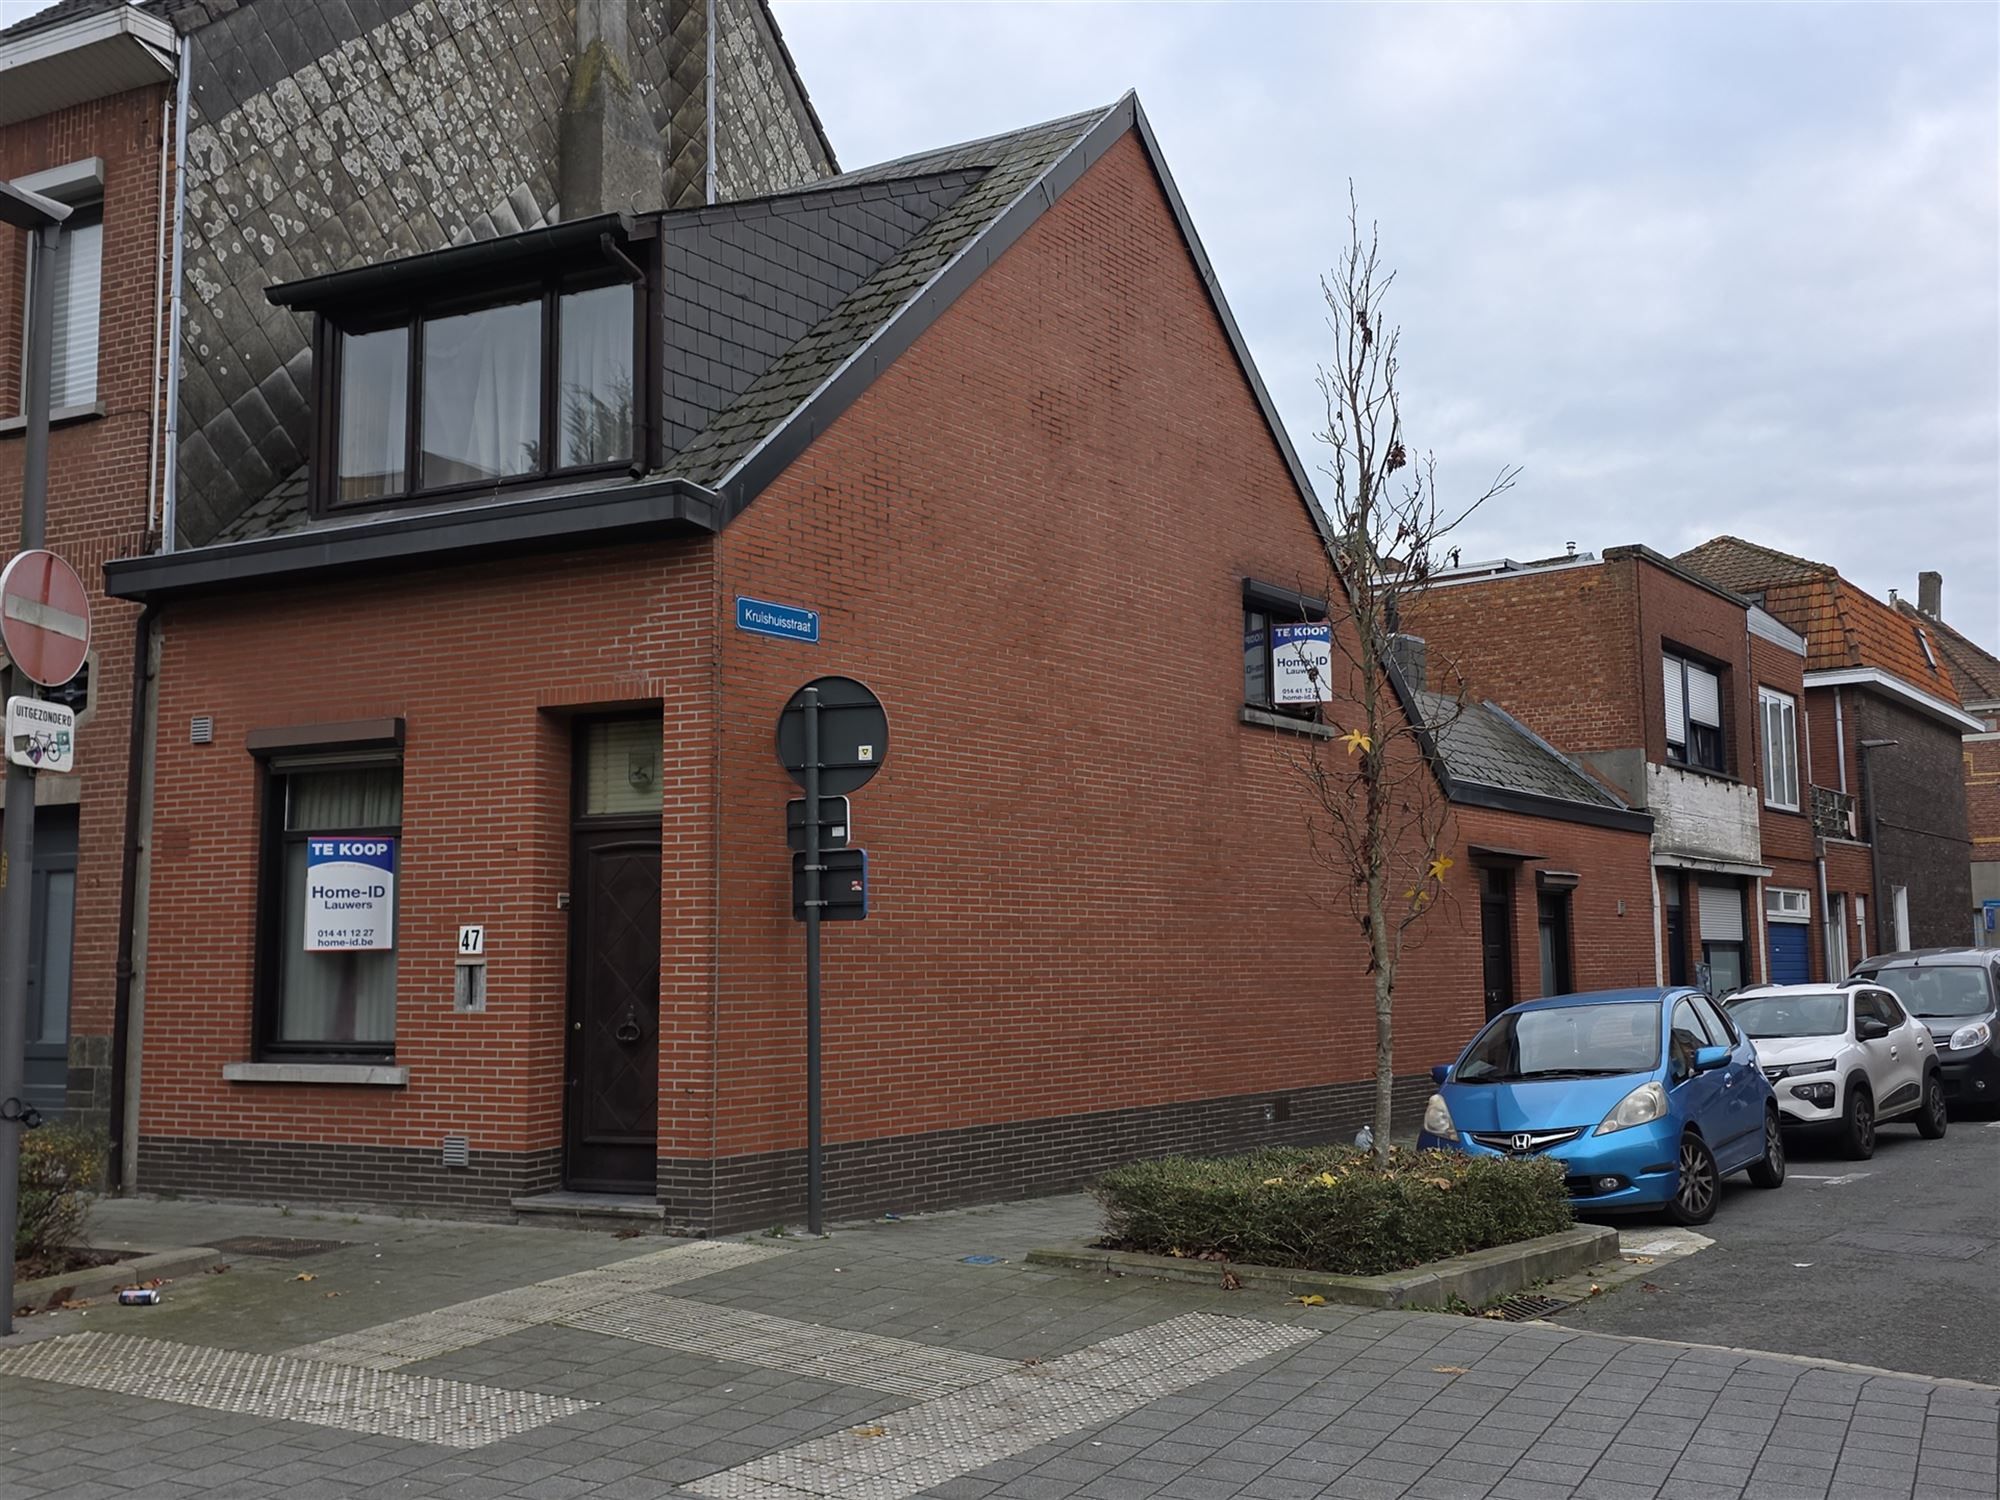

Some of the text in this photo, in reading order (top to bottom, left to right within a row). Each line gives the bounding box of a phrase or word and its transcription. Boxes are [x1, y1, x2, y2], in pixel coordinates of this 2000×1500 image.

[745, 608, 811, 633] Kruishuisstraat
[1275, 626, 1328, 637] TE KOOP
[16, 705, 72, 727] UITGEZONDERD
[311, 843, 388, 856] TE KOOP
[312, 886, 386, 899] Home-ID
[324, 901, 373, 910] Lauwers
[317, 929, 374, 938] 014 41 12 27
[461, 929, 480, 951] 47
[317, 938, 374, 947] home-id.be
